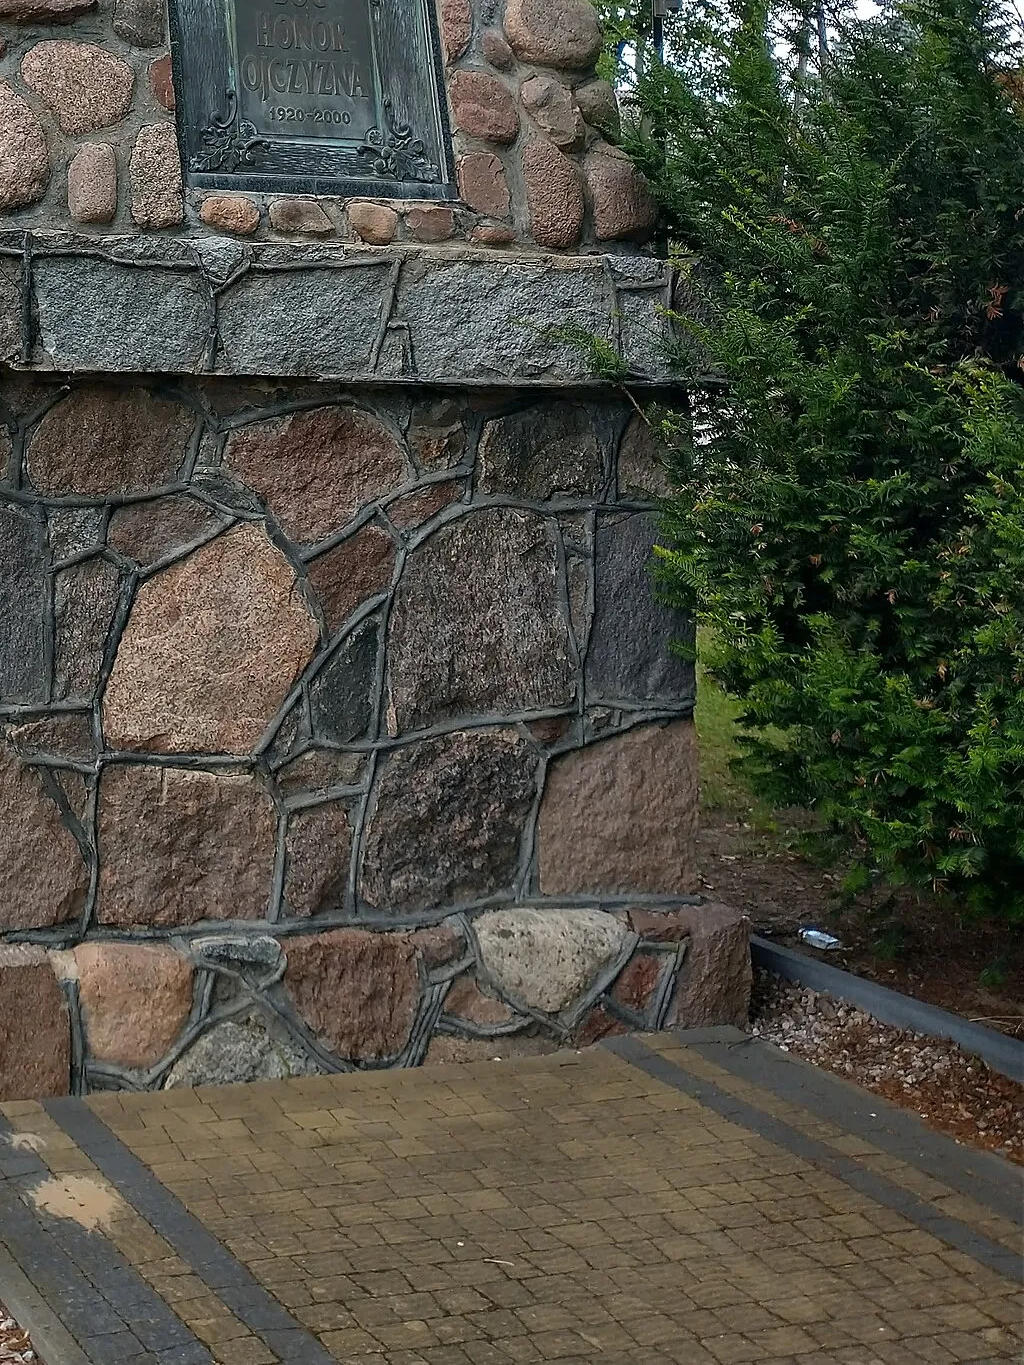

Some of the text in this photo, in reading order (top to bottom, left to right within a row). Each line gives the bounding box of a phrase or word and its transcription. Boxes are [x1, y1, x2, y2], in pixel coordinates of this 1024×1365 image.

[256, 11, 349, 52] HONOR
[241, 54, 369, 101] OJCZYZNA
[269, 106, 351, 125] 1920-2000
